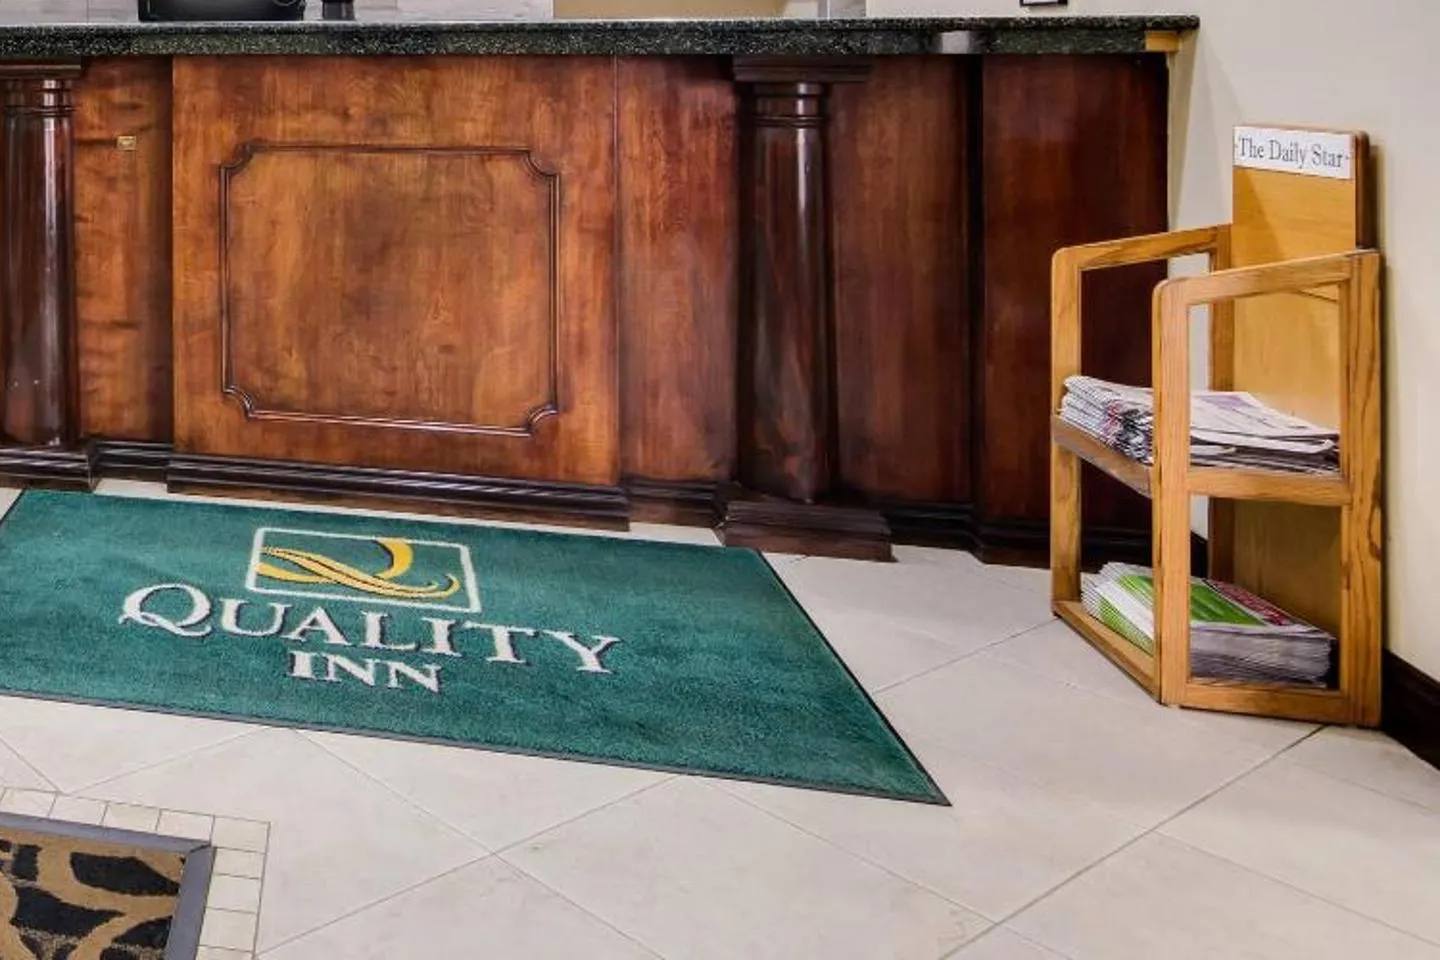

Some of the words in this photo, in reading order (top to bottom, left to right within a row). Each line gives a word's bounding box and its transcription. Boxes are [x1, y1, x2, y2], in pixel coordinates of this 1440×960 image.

[1238, 136, 1265, 159] The
[1269, 139, 1305, 169] Daily
[1311, 142, 1344, 168] Star
[118, 582, 621, 674] QUALITY
[286, 649, 442, 693] INN
